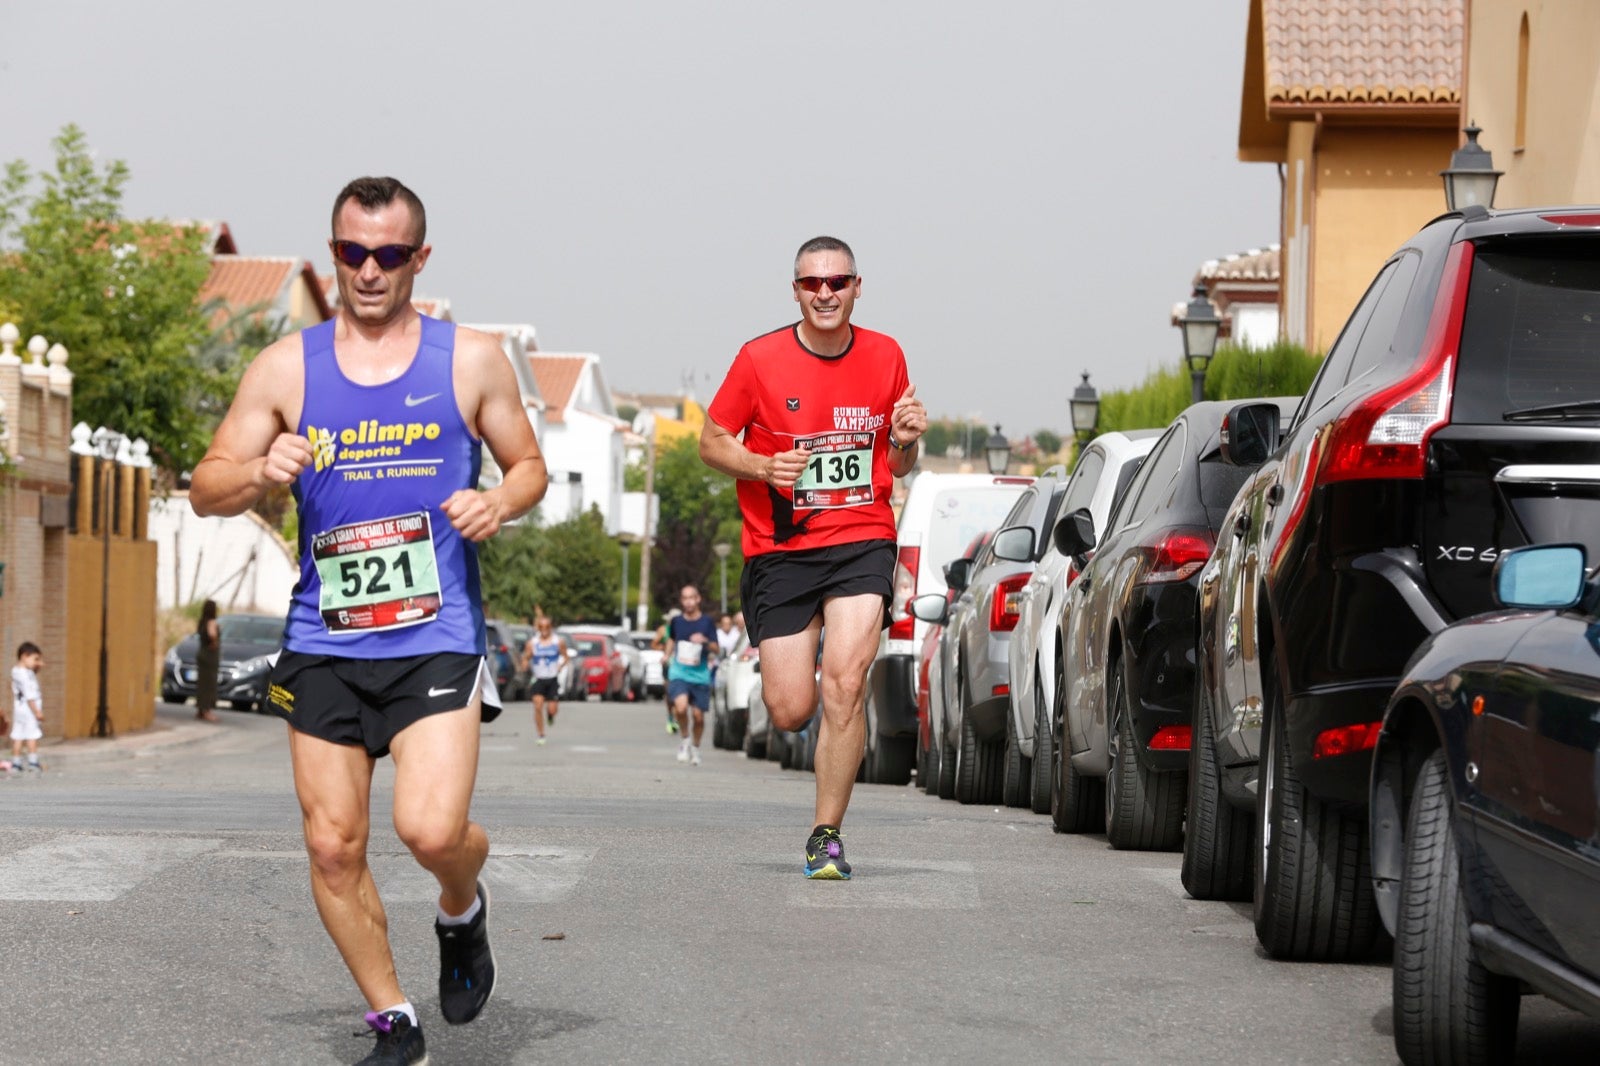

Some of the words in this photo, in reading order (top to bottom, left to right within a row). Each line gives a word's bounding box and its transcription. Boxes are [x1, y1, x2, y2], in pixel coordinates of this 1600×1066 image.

[833, 407, 870, 416] RUNNING
[833, 414, 885, 431] VAMPIROS
[340, 420, 440, 445] olimpo
[846, 434, 853, 443] DE
[339, 446, 401, 461] deportes
[343, 467, 373, 482] TRAIL
[376, 466, 384, 479] &
[387, 466, 436, 478] RUNNING
[809, 454, 860, 484] 136
[335, 528, 356, 544] GRAN
[355, 523, 384, 541] PREMIO
[384, 520, 395, 534] DE
[396, 517, 422, 533] FONDO
[340, 551, 414, 597] 521
